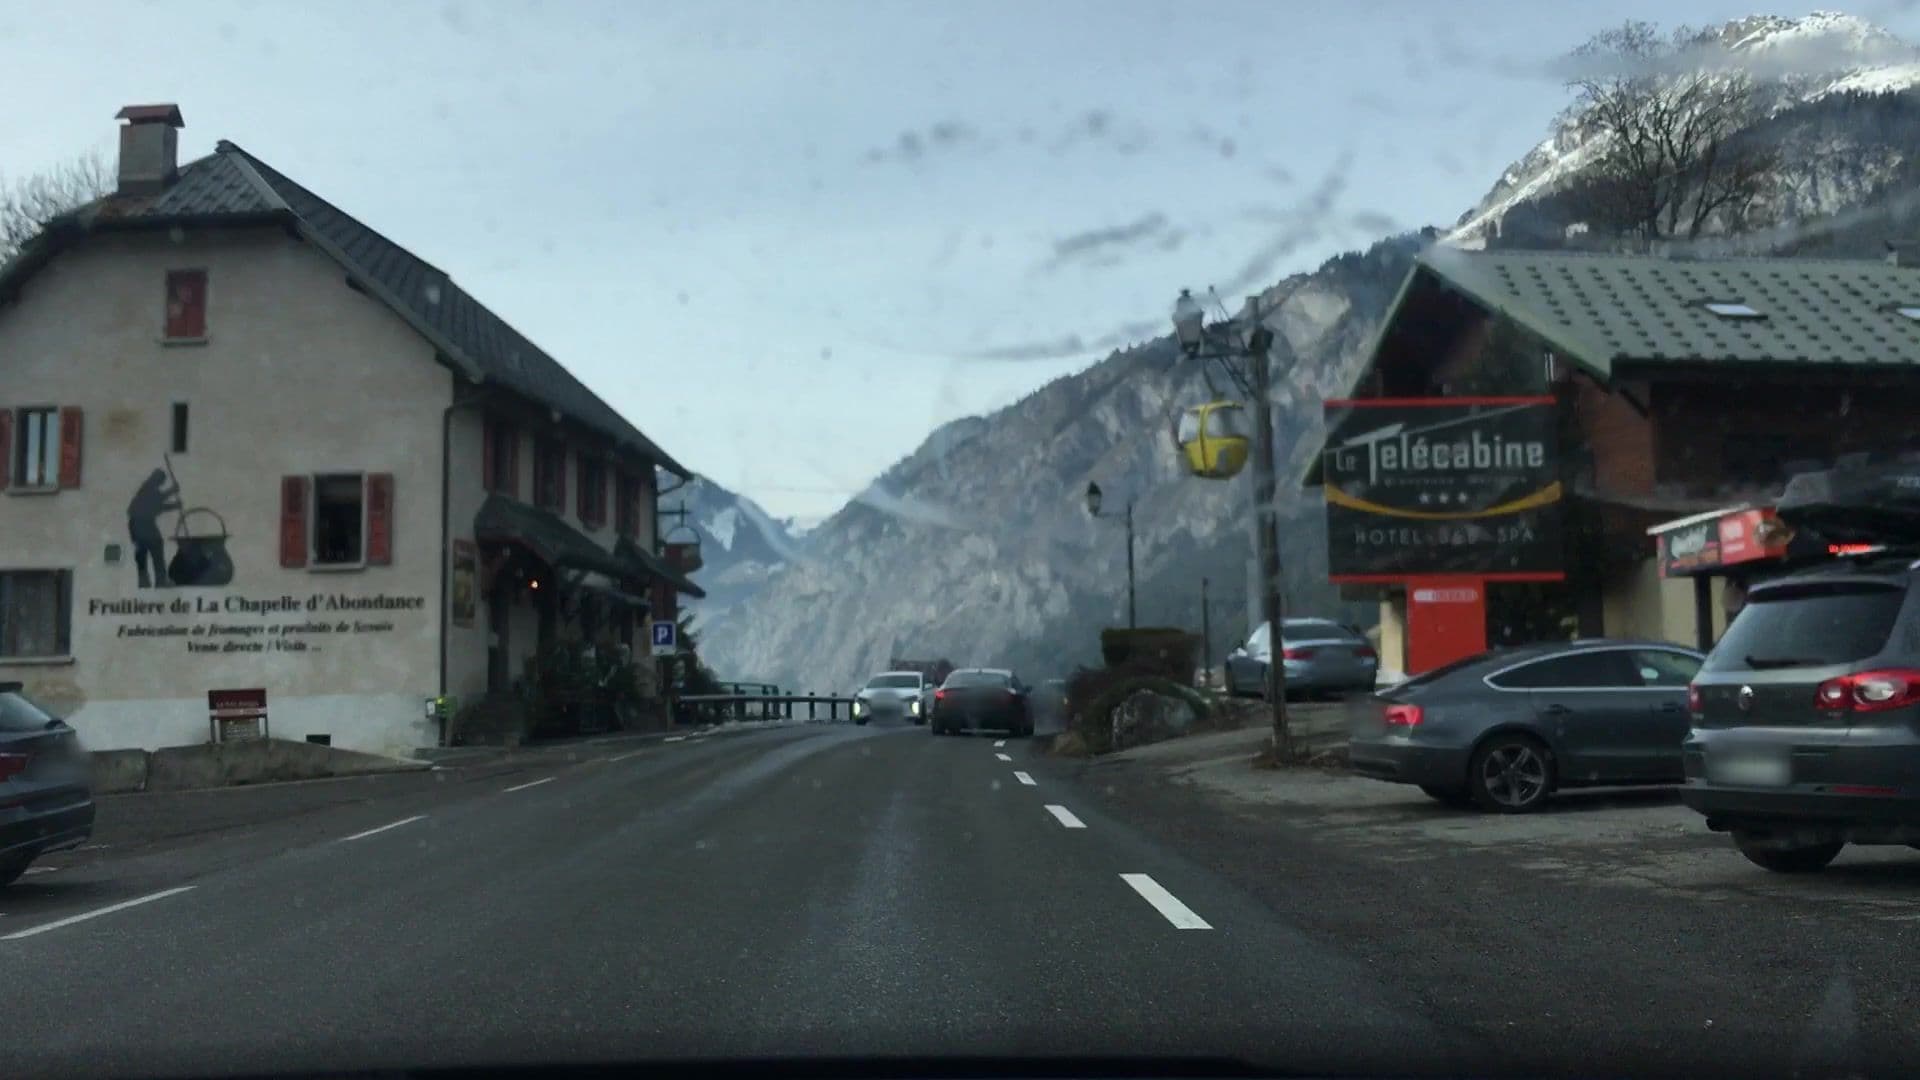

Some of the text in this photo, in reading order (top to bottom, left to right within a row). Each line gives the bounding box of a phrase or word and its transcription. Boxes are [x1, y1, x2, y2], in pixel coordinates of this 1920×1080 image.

[1335, 449, 1357, 472] Le
[1496, 527, 1534, 544] SPA
[169, 597, 190, 614] de
[196, 596, 219, 613] La
[225, 595, 302, 616] Chapelle
[306, 593, 425, 611] d'Abondance
[657, 626, 669, 643] P
